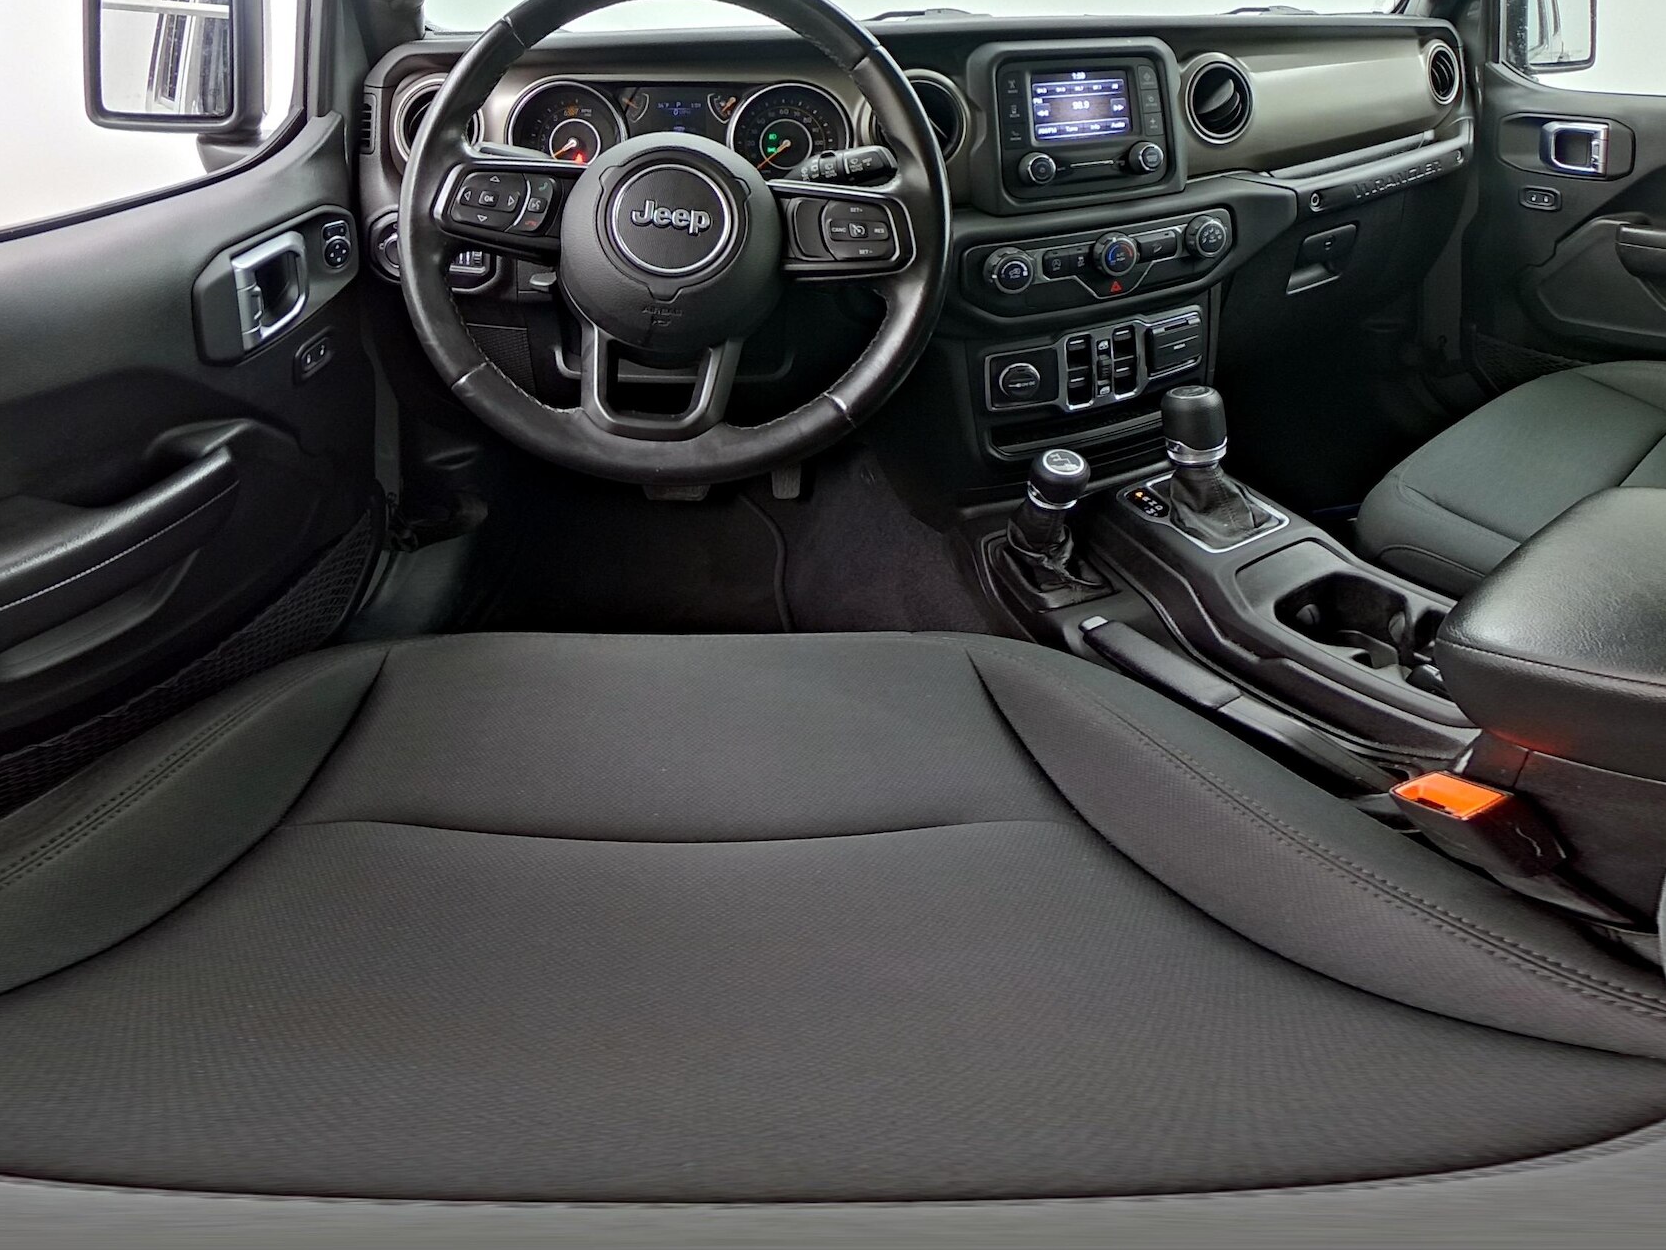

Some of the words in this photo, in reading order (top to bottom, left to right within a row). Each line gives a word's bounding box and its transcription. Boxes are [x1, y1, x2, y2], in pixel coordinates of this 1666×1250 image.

[1353, 160, 1441, 199] WRANGLER
[483, 194, 494, 203] OK
[631, 199, 711, 236] Jeep
